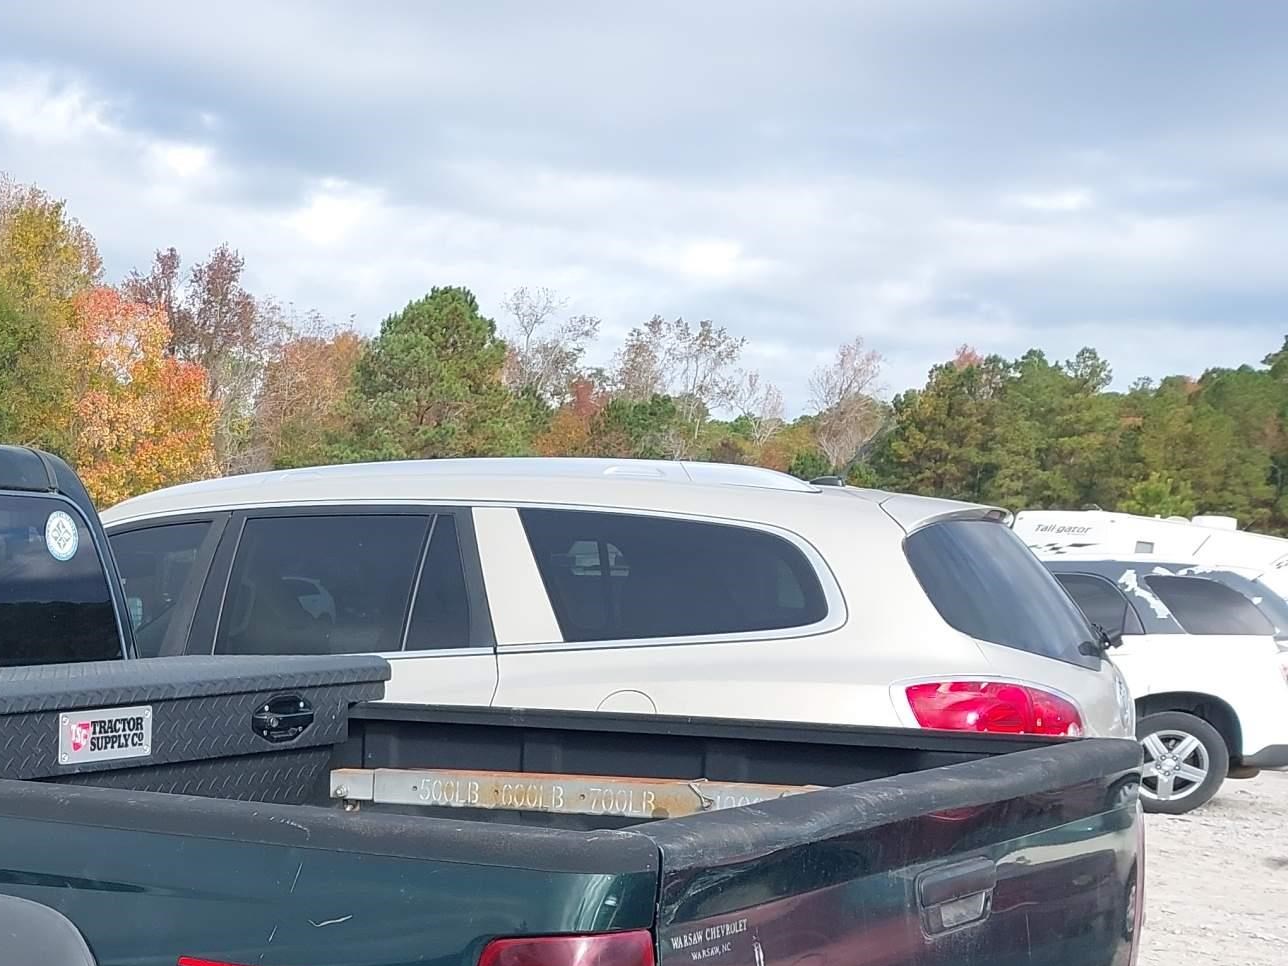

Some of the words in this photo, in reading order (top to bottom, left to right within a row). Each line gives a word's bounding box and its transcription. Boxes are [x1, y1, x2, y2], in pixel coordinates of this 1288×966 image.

[91, 716, 144, 735] TRACTOR
[89, 733, 131, 752] SUPPLY
[419, 778, 479, 804] 500LB
[671, 930, 704, 950] WARSAW
[704, 918, 748, 942] CHEVROLET
[721, 942, 732, 953] NC
